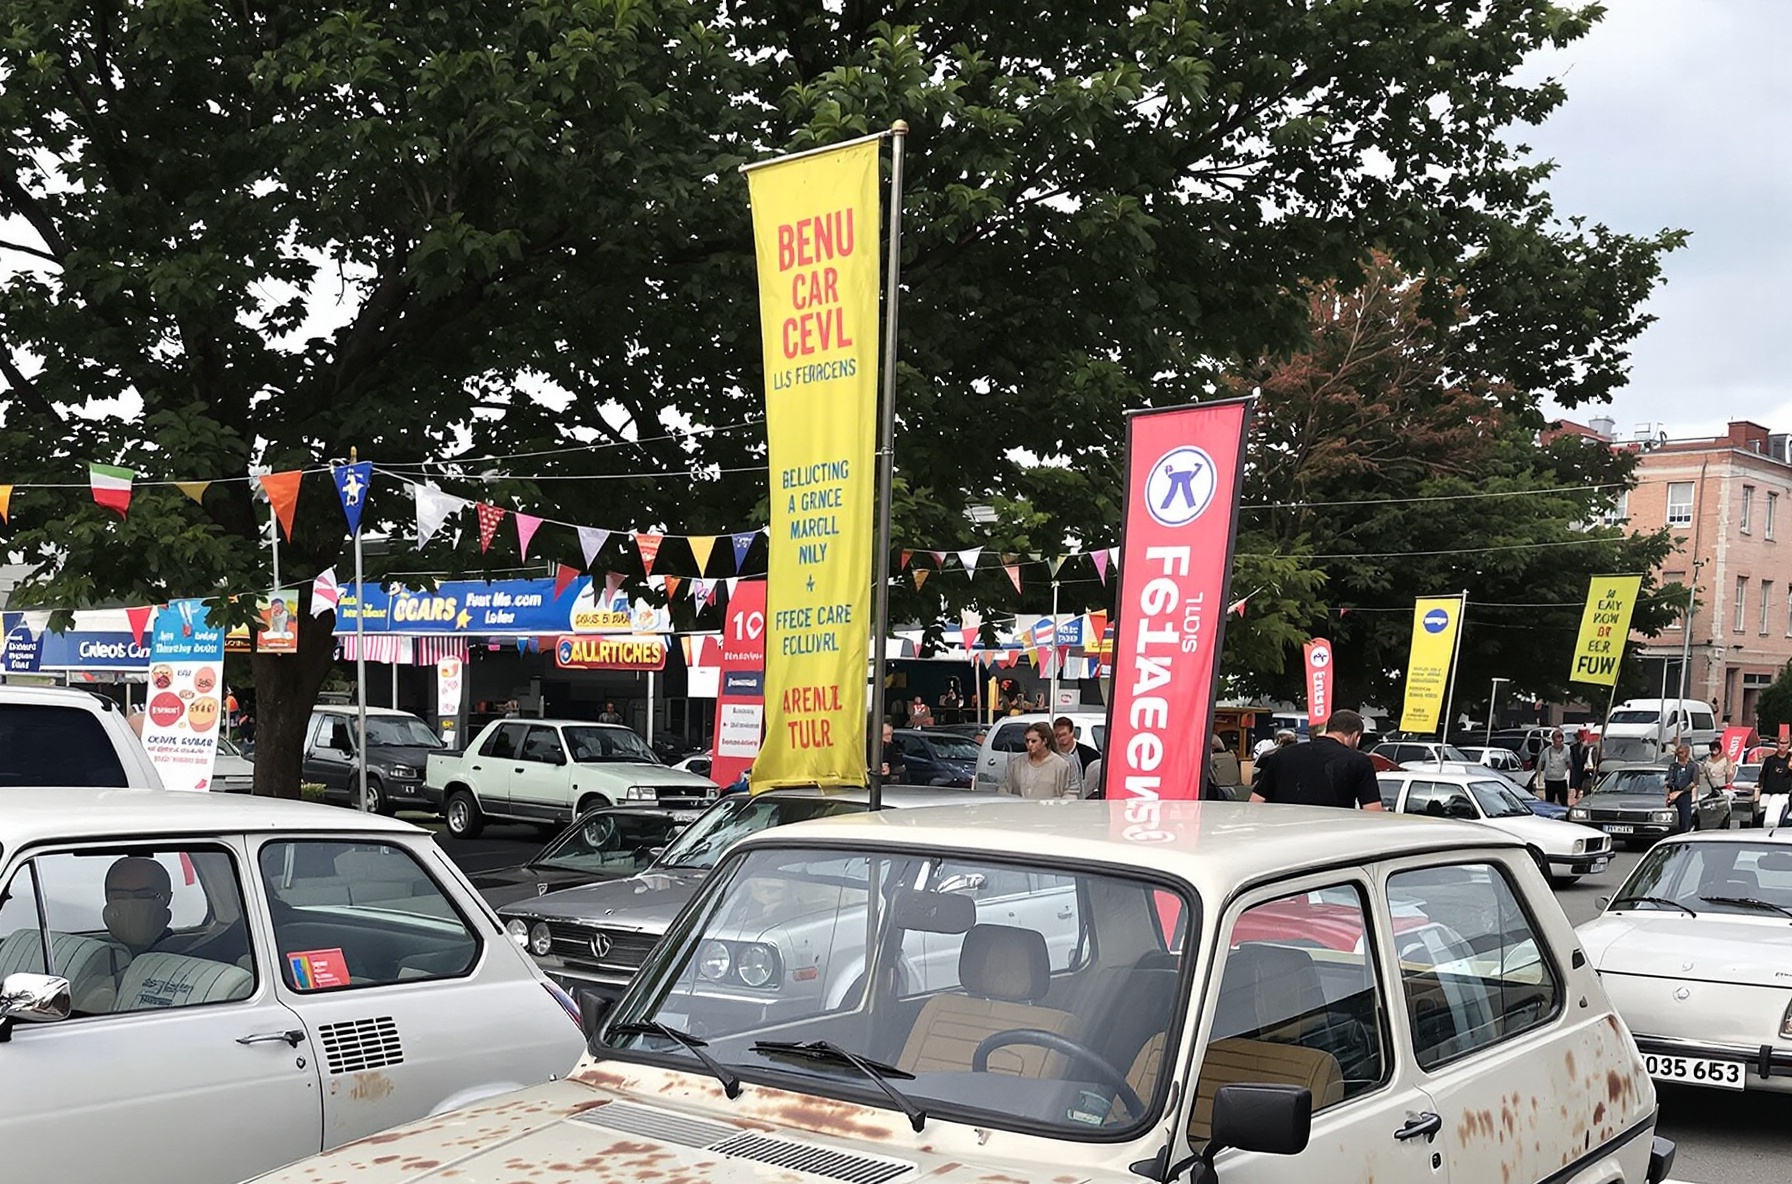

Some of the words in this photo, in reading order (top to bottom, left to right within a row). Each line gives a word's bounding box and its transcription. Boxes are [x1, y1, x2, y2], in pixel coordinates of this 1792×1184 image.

[778, 207, 854, 272] BENU
[792, 267, 839, 311] CAR
[782, 307, 852, 360] CEVL
[788, 494, 796, 514] A
[732, 610, 765, 641] 10
[817, 604, 852, 625] CARE
[1577, 655, 1616, 675] FUW
